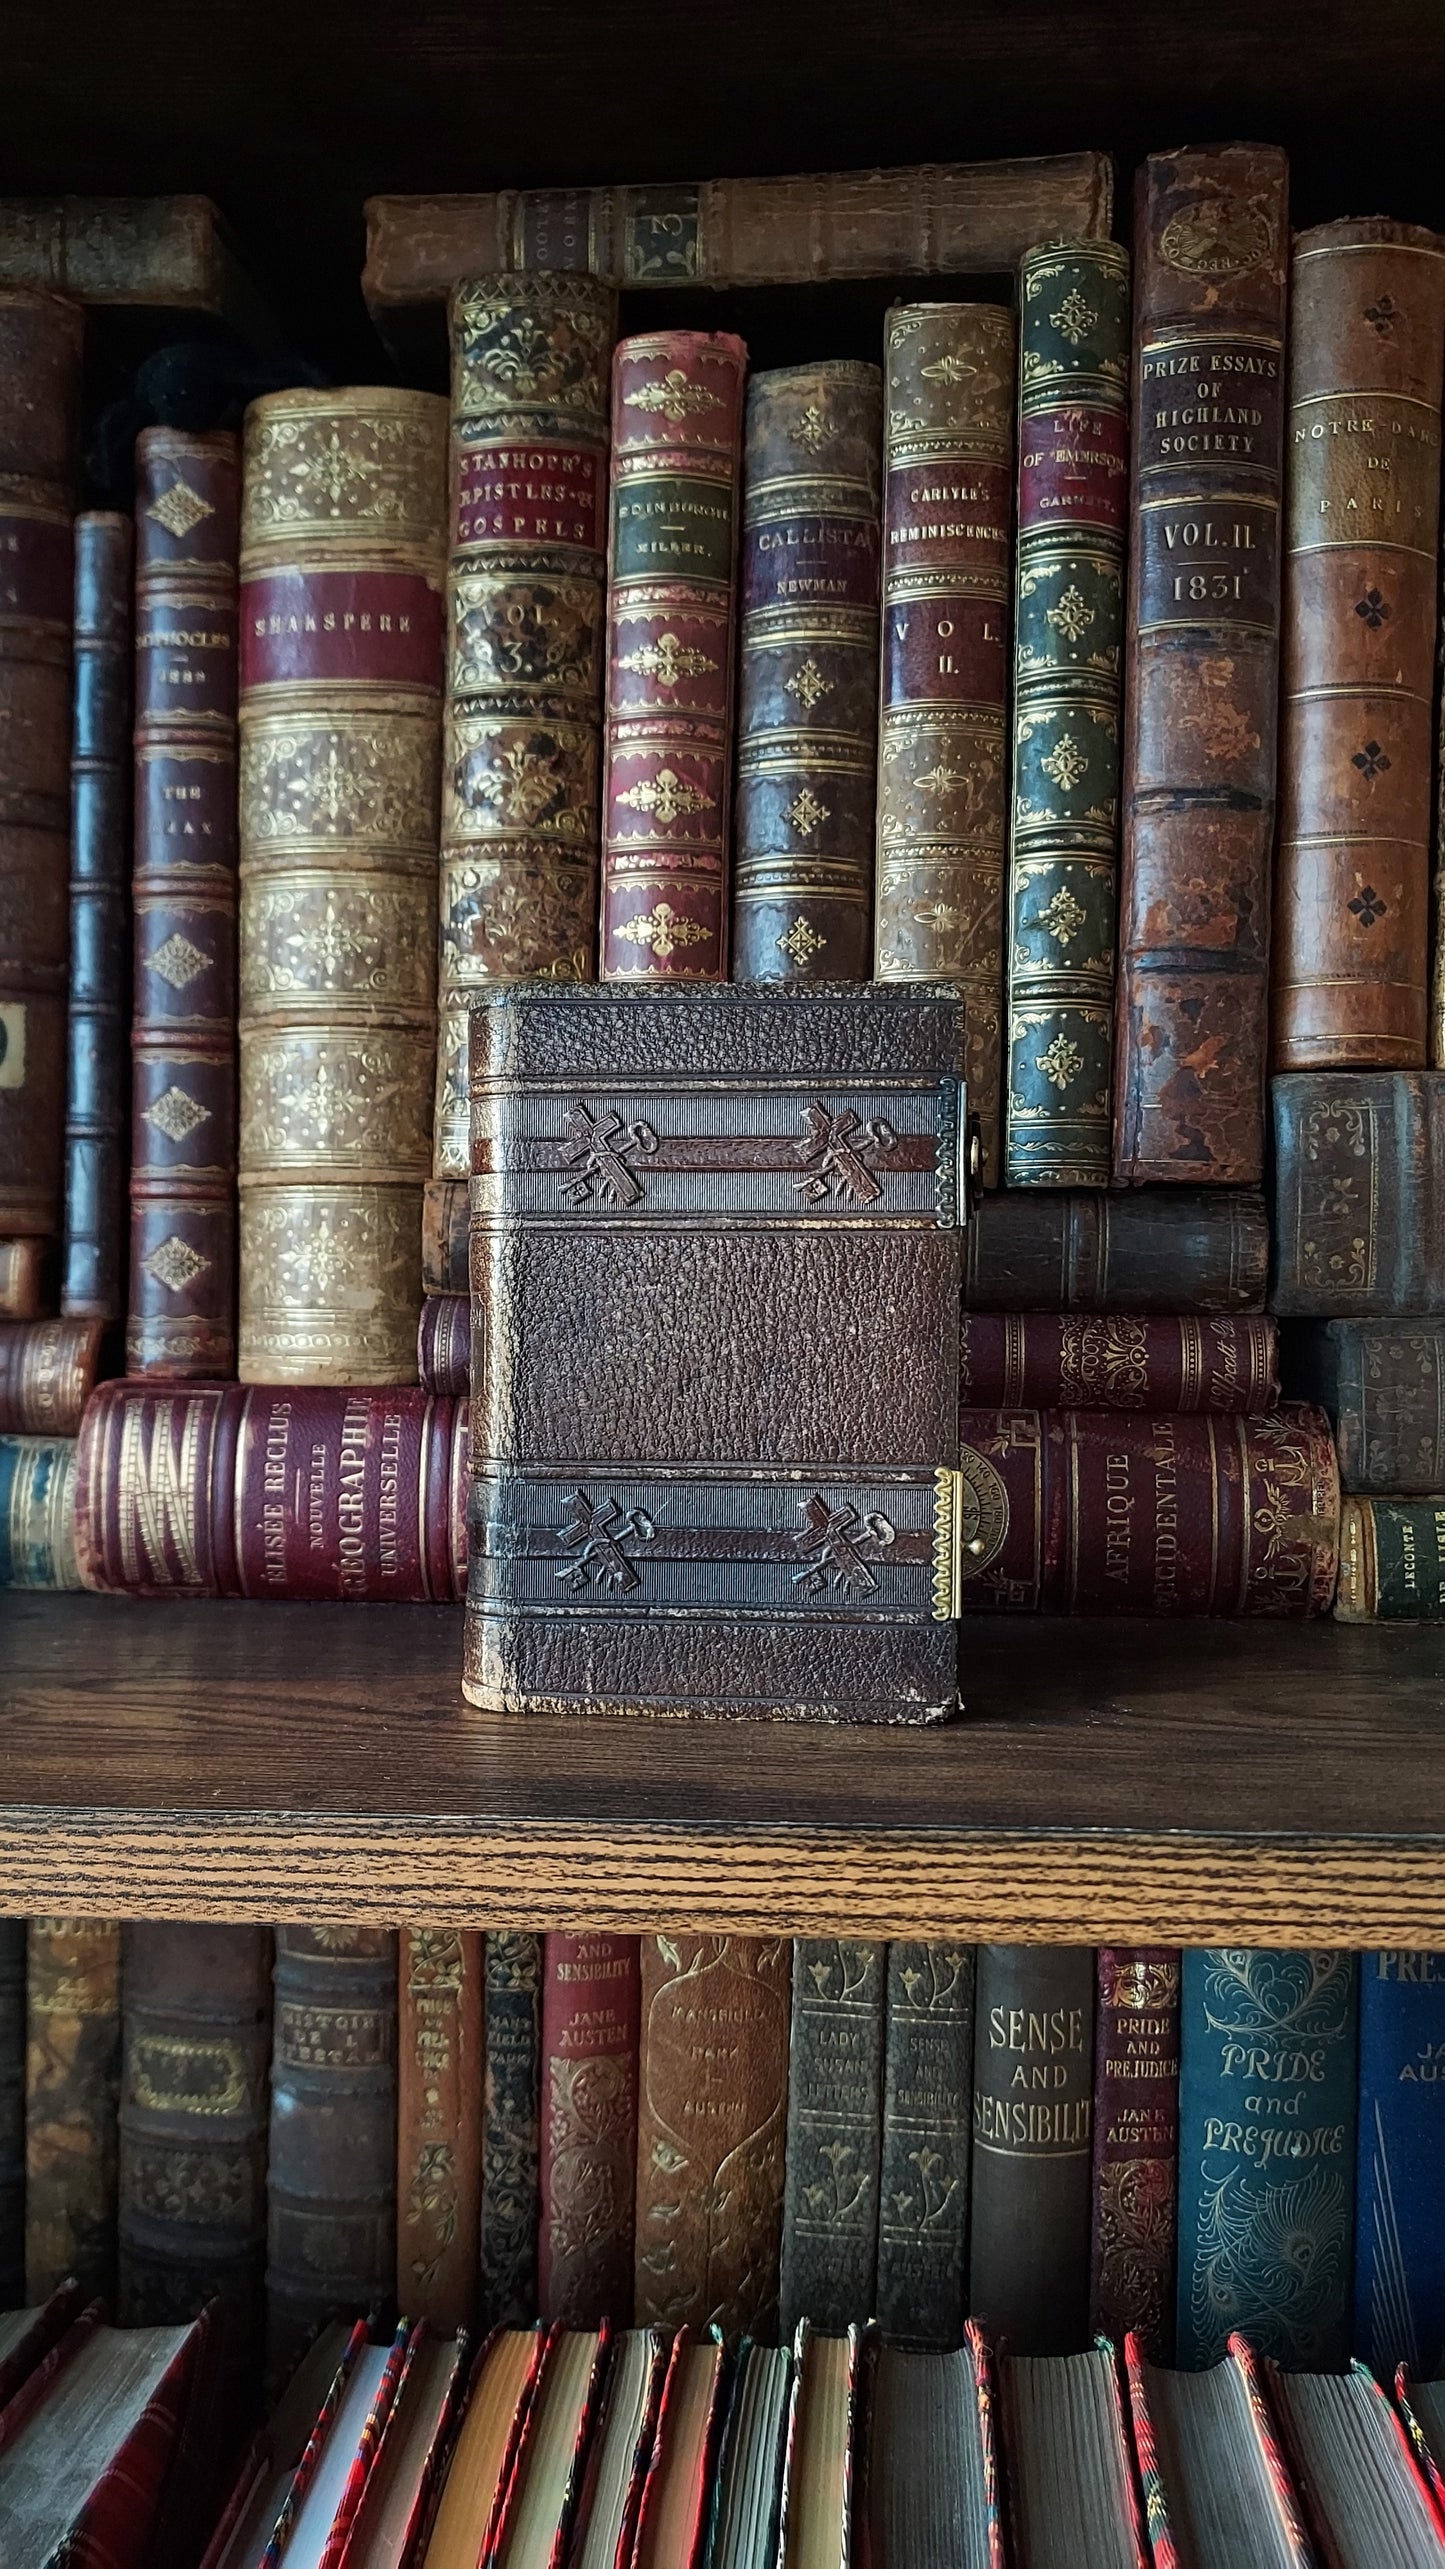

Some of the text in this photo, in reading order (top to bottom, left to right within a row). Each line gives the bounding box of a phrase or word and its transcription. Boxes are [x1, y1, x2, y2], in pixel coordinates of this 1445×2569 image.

[1142, 353, 1277, 381] PRIZE ESSAYS
[1196, 381, 1223, 399] OF
[1053, 418, 1104, 436] LIFE
[1154, 406, 1264, 429] HIGHLAND
[1159, 433, 1255, 455] SOCIETY
[459, 452, 594, 479] STANHOPE'S
[1023, 451, 1045, 469] OF
[1366, 456, 1391, 471] DE
[910, 482, 991, 503] CARLYLE'S
[1318, 496, 1425, 519] PARIS
[458, 514, 586, 540] GOSPELS
[758, 527, 870, 551] CALLISTA
[776, 578, 848, 595] NEWMAN
[1173, 574, 1243, 602] 1831
[938, 655, 960, 675] II.
[162, 785, 202, 800] THE
[263, 1402, 293, 1493] RECLUS
[309, 1443, 326, 1551] NOUVELLE
[331, 1396, 373, 1593] GÉOGRAPHIE
[379, 1413, 401, 1577] UNIVERSELLE
[1105, 1454, 1136, 1585] AFRIQUE
[1402, 1525, 1416, 1589] LECONTE
[576, 1942, 613, 1960] AND
[556, 1956, 632, 1983] SENSIBILITY
[568, 2008, 616, 2027] JANE
[1116, 2017, 1171, 2036] PRIDE
[558, 2023, 628, 2048] AUSTEN
[818, 2030, 858, 2047] LADY
[988, 2004, 1084, 2055] SENSE
[1126, 2040, 1161, 2056] AND
[813, 2057, 866, 2074] SUSAN
[1105, 2057, 1179, 2079] PREJUDICE
[1219, 2042, 1327, 2083] PRIDE
[1010, 2063, 1068, 2090] AND
[1243, 2090, 1307, 2116] and
[973, 2090, 1091, 2146] SENSIBILIT
[1117, 2107, 1166, 2124] JANE
[1106, 2124, 1175, 2145] AUSTEN
[1202, 2116, 1346, 2171] PREJUDICE
